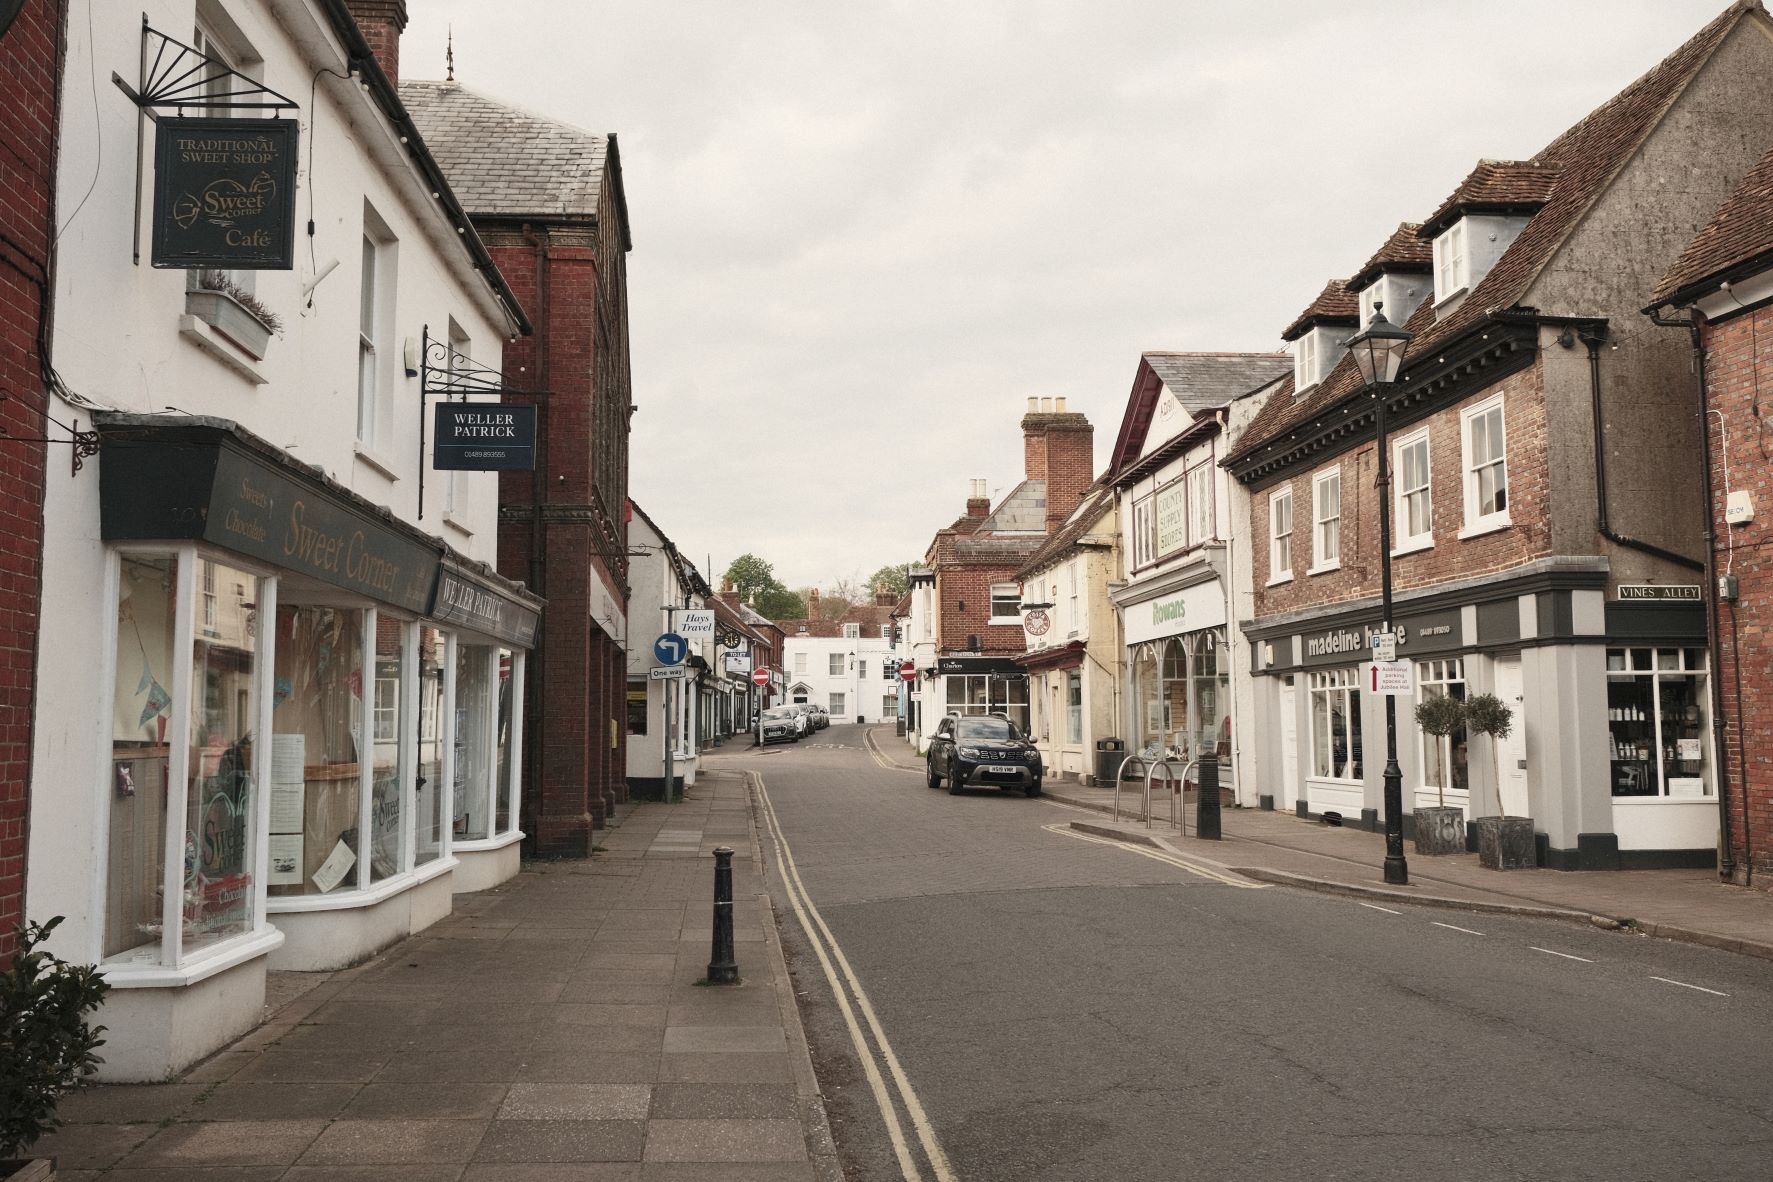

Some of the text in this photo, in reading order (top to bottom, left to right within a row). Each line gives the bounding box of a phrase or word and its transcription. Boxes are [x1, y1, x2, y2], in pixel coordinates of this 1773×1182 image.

[177, 139, 277, 151] TRADITIONAL
[182, 152, 273, 164] SWEET SHOP
[204, 191, 265, 213] Sweet
[226, 229, 270, 246] Café
[454, 413, 514, 424] WELLER
[454, 426, 515, 437] PATRICK
[1158, 490, 1183, 514] COUNTY
[225, 508, 267, 543] Chocolate
[1160, 510, 1181, 531] SUPPLY
[284, 500, 344, 573] Sweet
[346, 530, 400, 593] Corner
[1161, 527, 1183, 549] STORES
[1621, 587, 1697, 598] VINES ALLEY
[473, 591, 503, 622] PATRICK
[1152, 599, 1186, 626] Rowans
[681, 623, 712, 632] Travel
[685, 614, 709, 625] Hays
[1308, 630, 1361, 656] madeline
[1375, 637, 1380, 647] P
